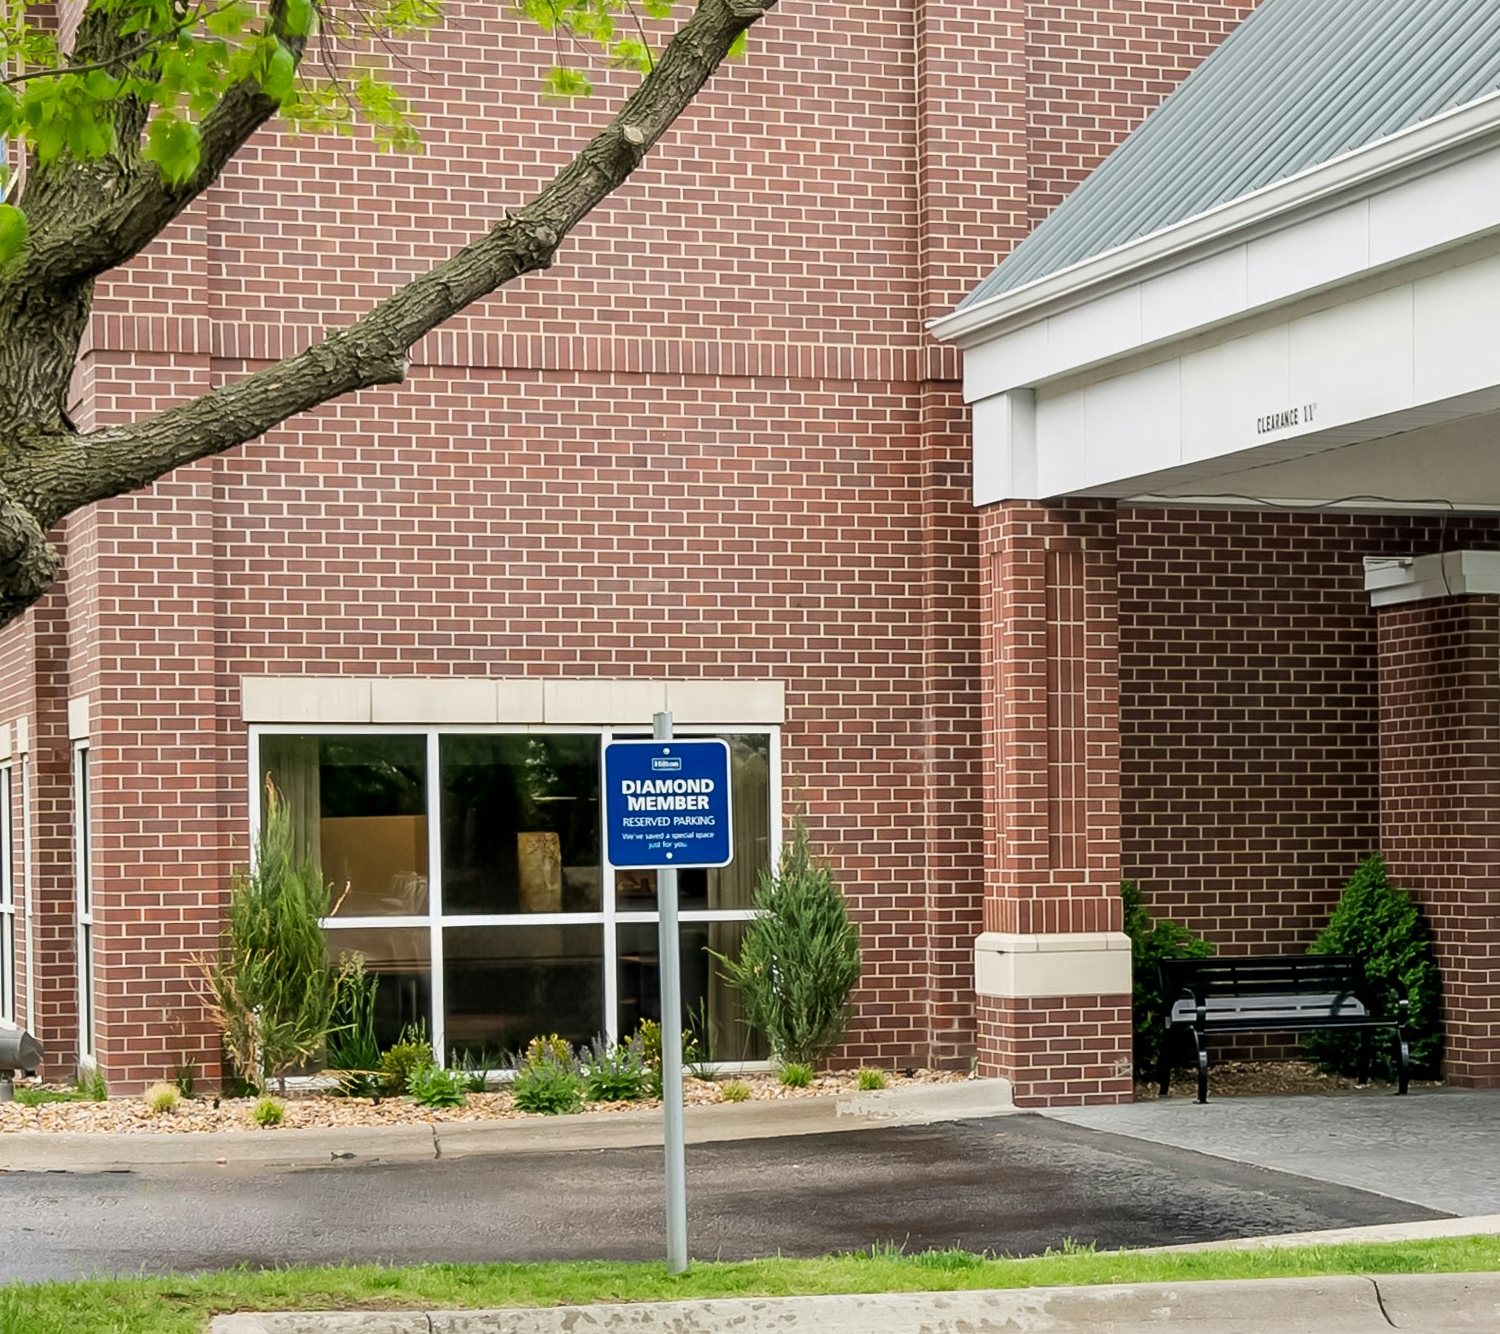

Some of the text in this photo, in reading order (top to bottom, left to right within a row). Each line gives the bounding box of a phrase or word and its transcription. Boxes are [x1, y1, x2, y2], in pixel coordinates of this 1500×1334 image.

[1257, 407, 1298, 434] CLEARANCE
[654, 760, 678, 768] Hilton
[621, 778, 714, 795] DIAMOND
[627, 795, 709, 812] MEMBER
[622, 815, 715, 827] RESERVED PARKING
[645, 832, 664, 840] saved
[671, 831, 694, 840] special
[662, 840, 672, 848] for
